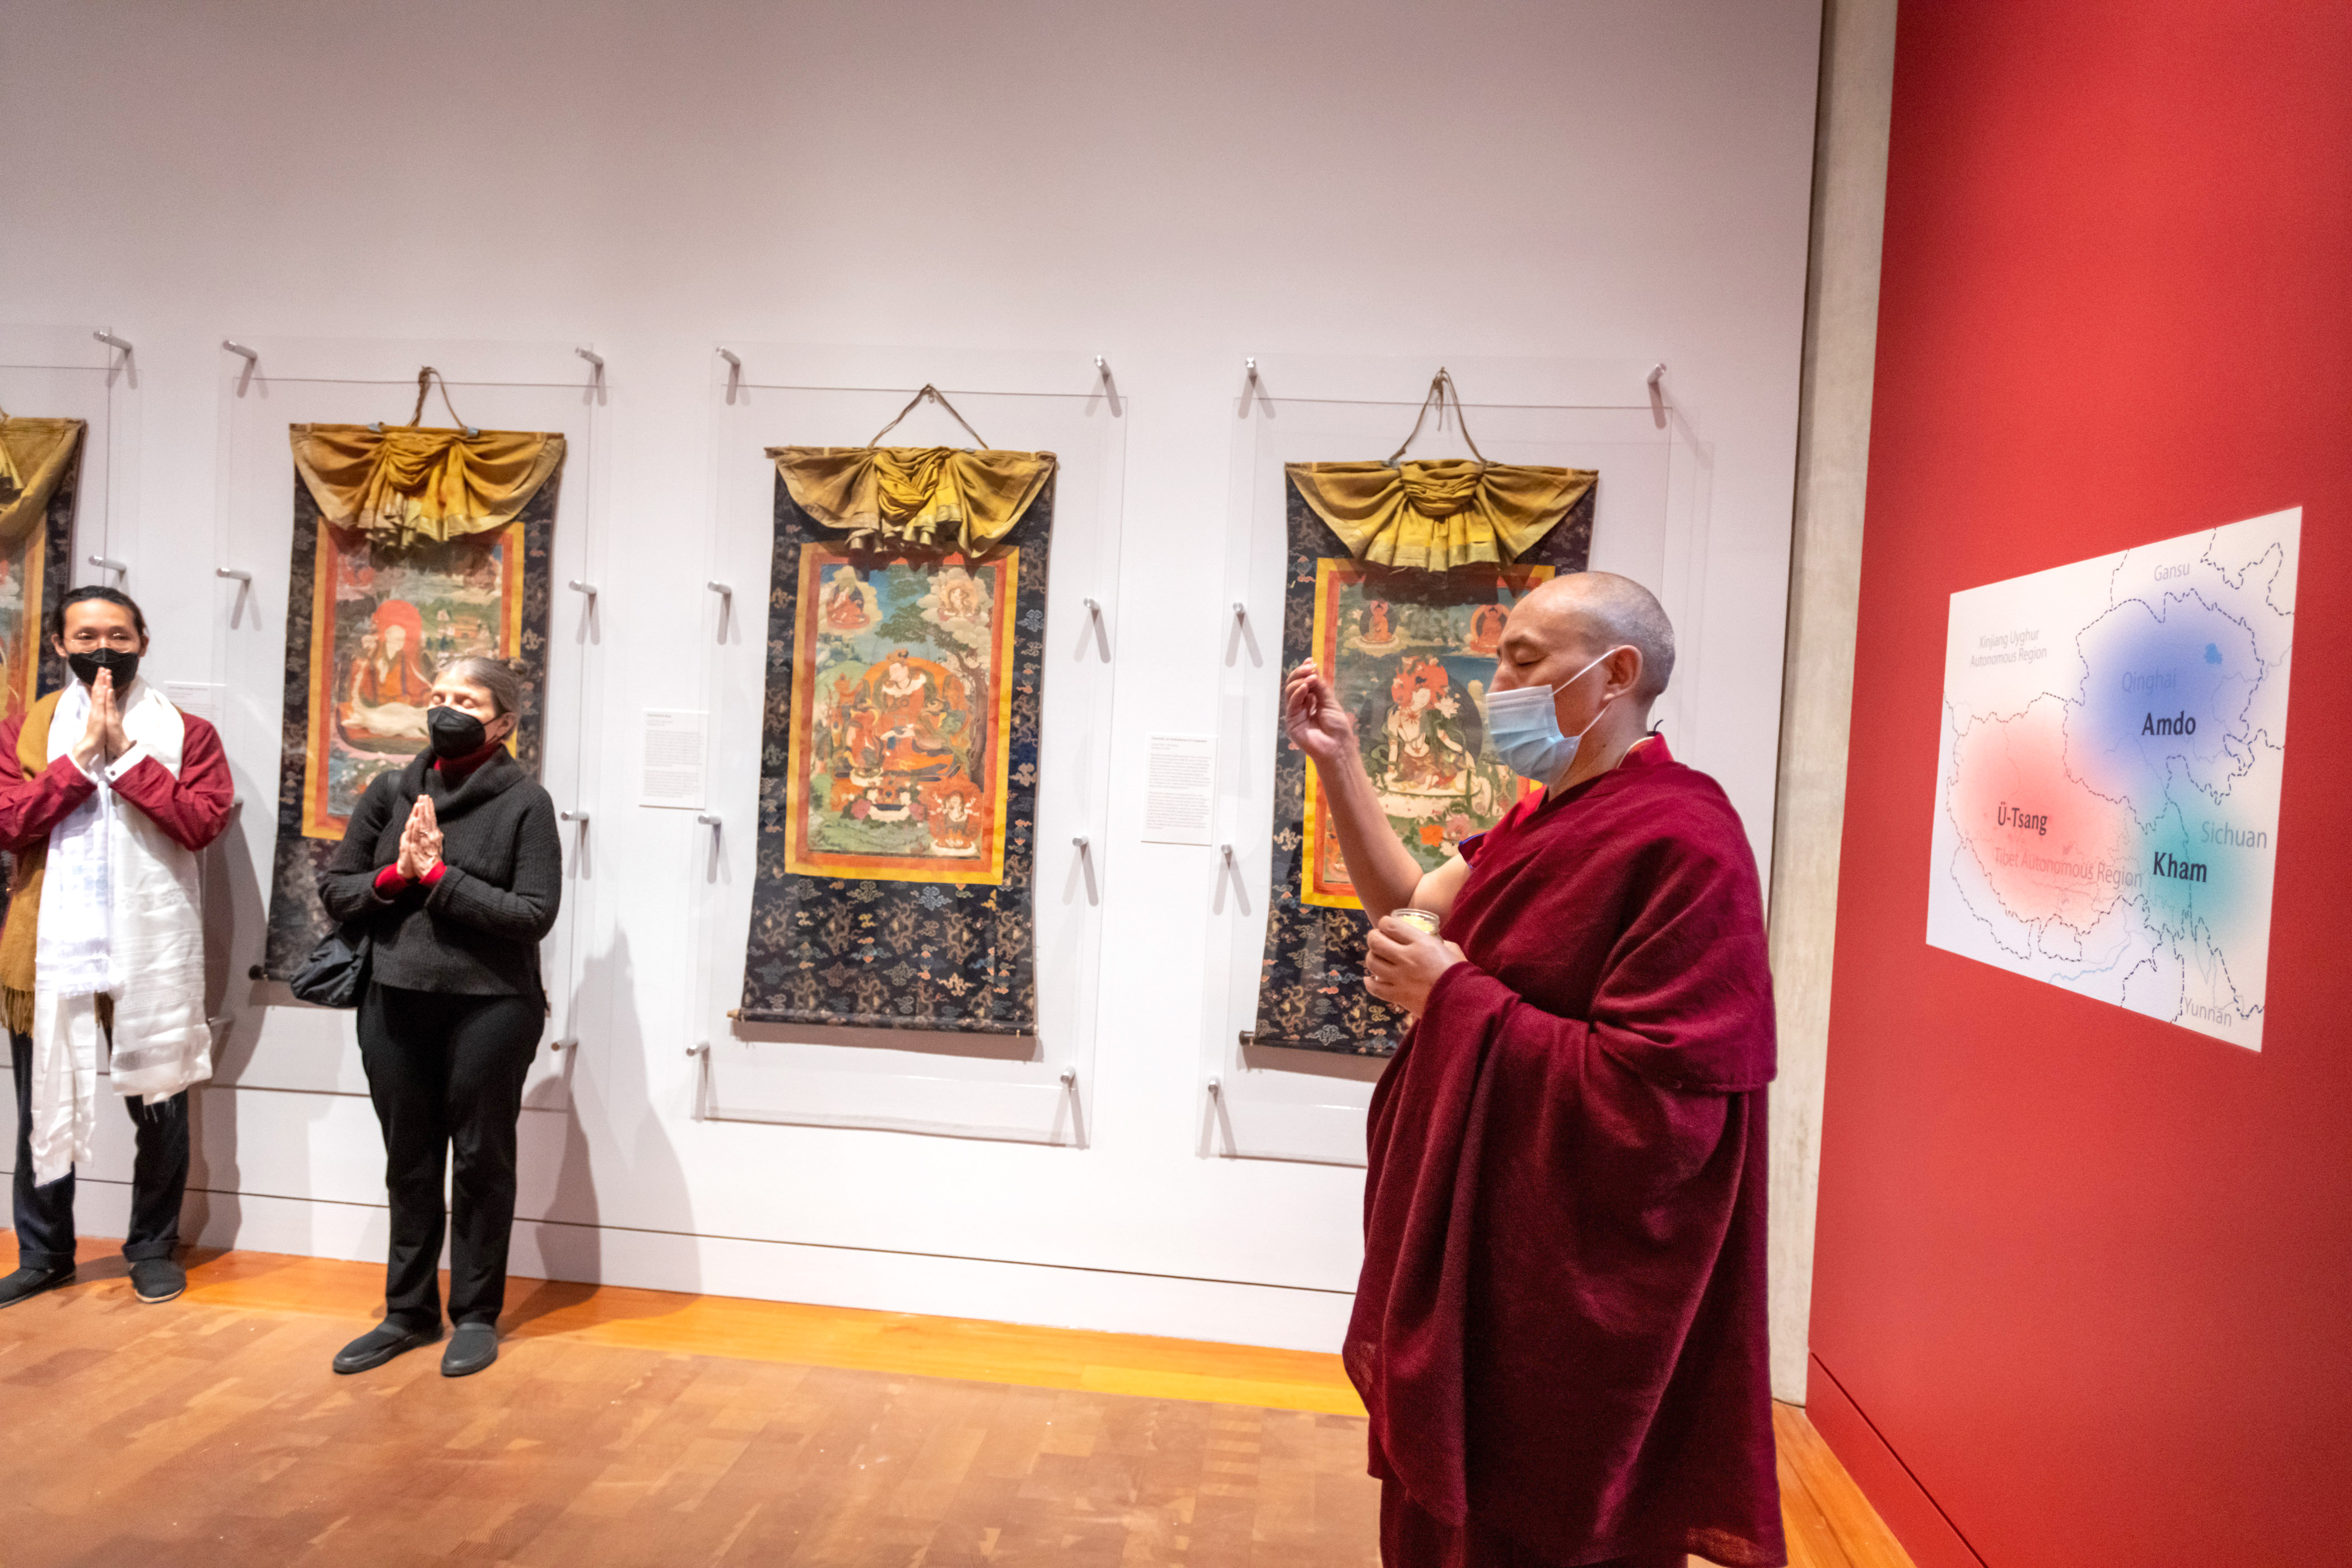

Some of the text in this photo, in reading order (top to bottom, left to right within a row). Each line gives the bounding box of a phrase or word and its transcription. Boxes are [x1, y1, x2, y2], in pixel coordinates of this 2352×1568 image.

[2154, 563, 2190, 582] Gansu
[1979, 627, 2040, 651] Xinjiang Uyghur
[1970, 646, 2047, 668] Autonomous Region
[2122, 668, 2177, 696] Qinghai
[2141, 710, 2196, 735] Amdo
[1998, 801, 2047, 836] Ü-Tsang
[2201, 820, 2267, 849] Sichuan
[1995, 847, 2143, 890] Tibet Autonomous Region
[2153, 851, 2207, 883] Kham
[2184, 996, 2232, 1028] Yunnan
